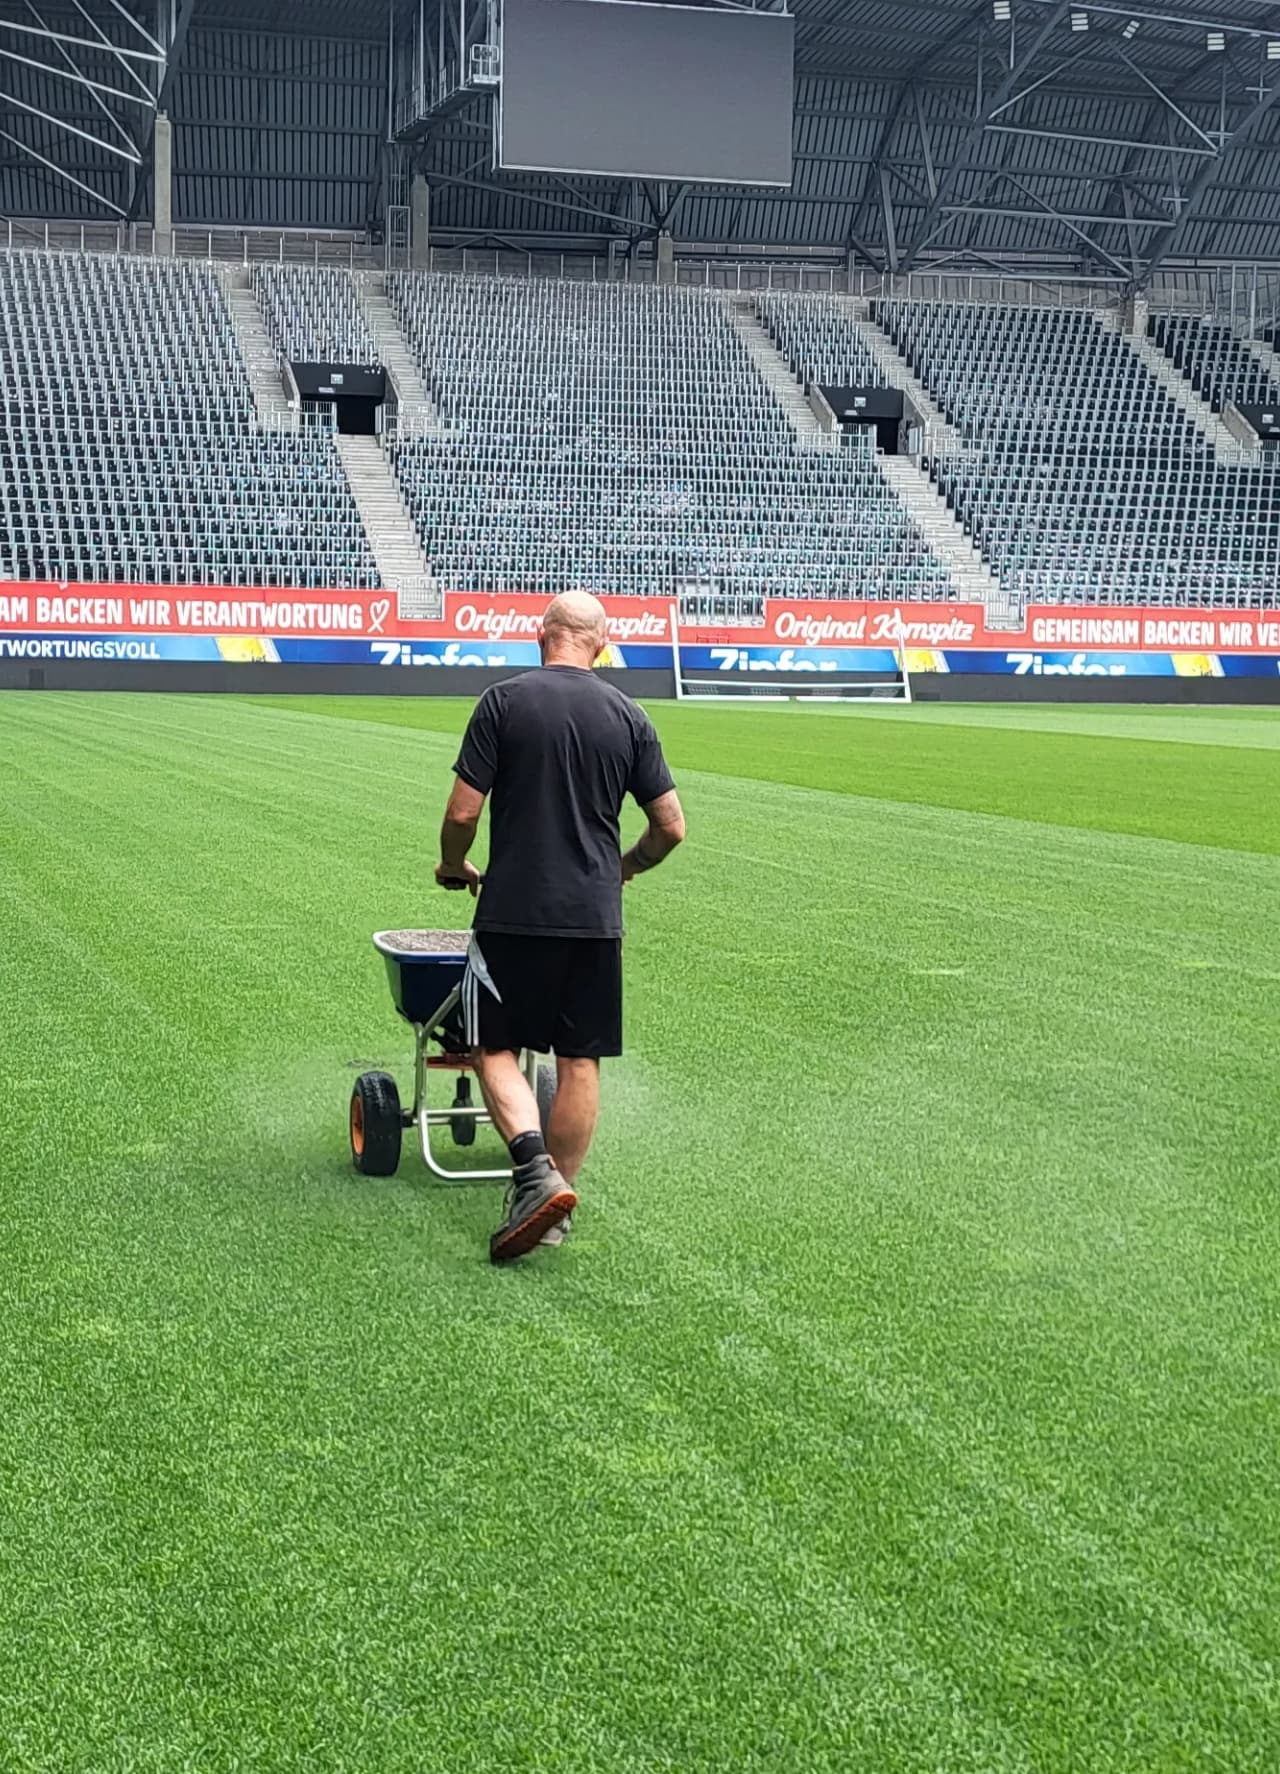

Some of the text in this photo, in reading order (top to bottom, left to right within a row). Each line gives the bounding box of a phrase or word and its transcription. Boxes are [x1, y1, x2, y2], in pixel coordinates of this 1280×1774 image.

[35, 598, 121, 625] BACKEN
[130, 599, 170, 625] WIR
[176, 600, 362, 629] VERANTWORTUNG
[605, 613, 667, 638] nspitz
[775, 612, 866, 645] Original
[1032, 618, 1139, 644] GEMEINSAM
[1144, 621, 1215, 645] BACKEN
[1220, 622, 1253, 646] WIR
